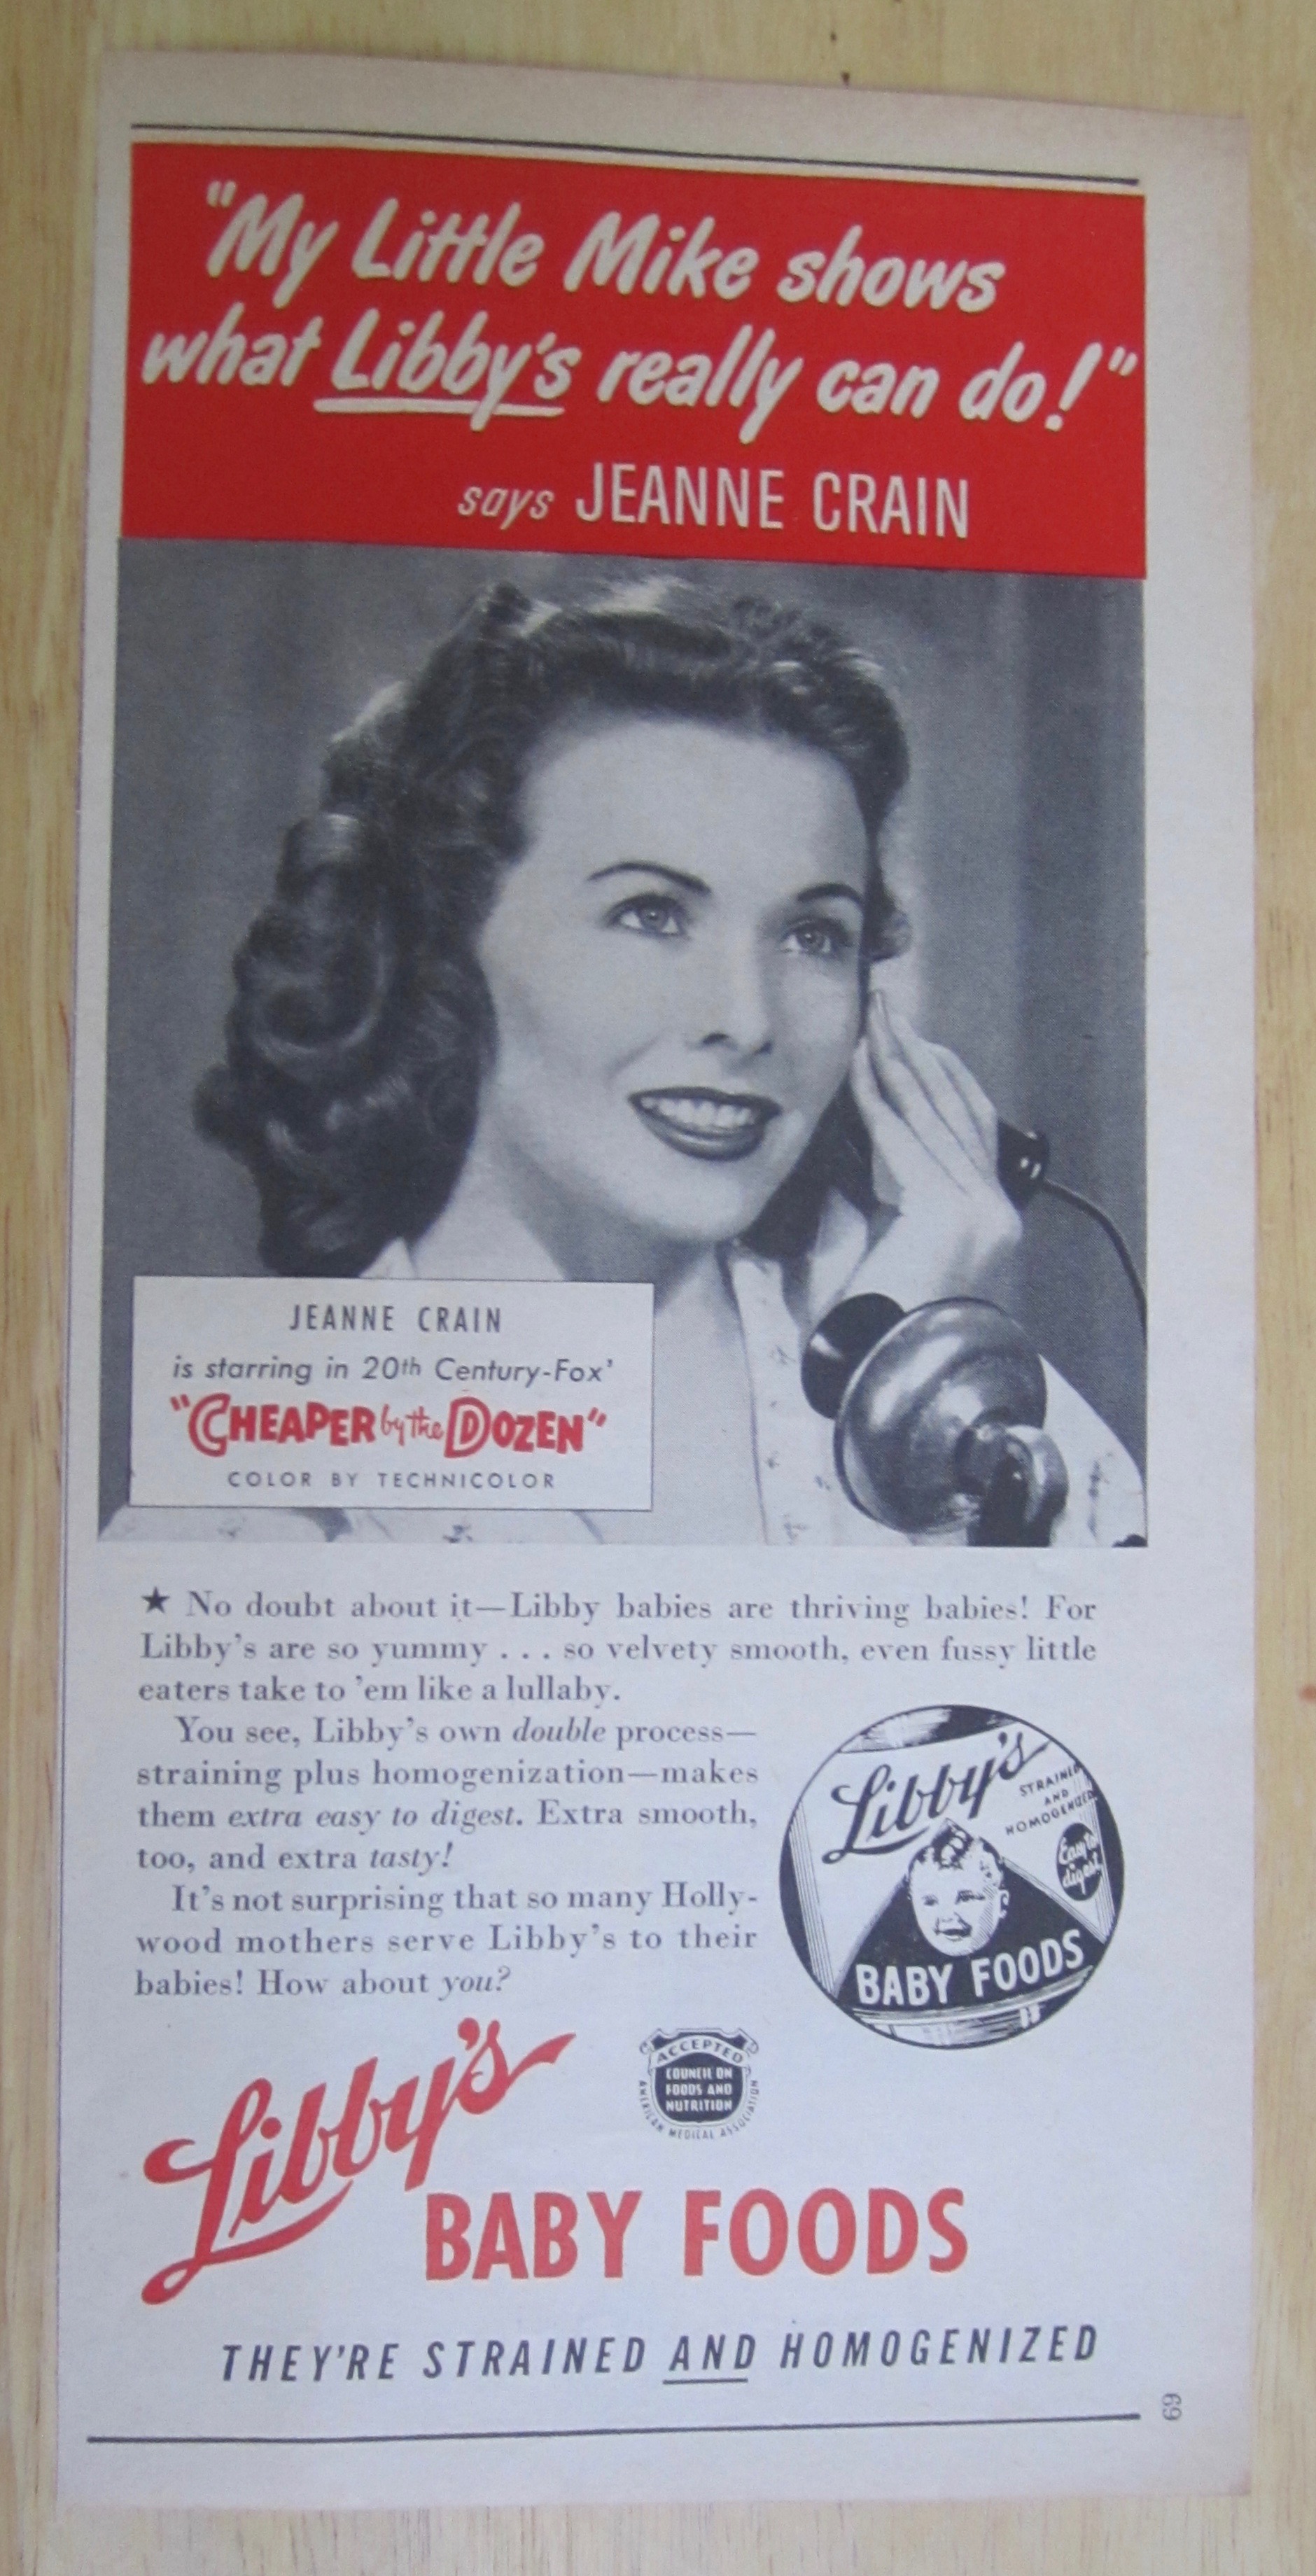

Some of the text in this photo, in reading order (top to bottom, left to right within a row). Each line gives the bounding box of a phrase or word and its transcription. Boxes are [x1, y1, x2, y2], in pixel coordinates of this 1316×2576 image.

[206, 180, 1006, 313] "My Little Mike shows
[141, 299, 1138, 444] what Libby's really can do!"
[457, 462, 968, 539] says JEANNE CRAIN
[289, 1303, 500, 1333] JEANNE CRAIN
[173, 1354, 193, 1379] is
[204, 1355, 313, 1386] starring
[326, 1355, 349, 1379] in
[361, 1355, 421, 1380] 20th
[171, 1393, 606, 1459] "CHEAPER by the DOZEN"
[227, 1471, 554, 1490] COLOR BY TECHNICOLOR
[189, 1590, 232, 1615] No
[246, 1591, 333, 1618] doubt
[351, 1592, 435, 1618] about
[617, 1592, 711, 1618] babies
[728, 1603, 773, 1618] are
[791, 1593, 909, 1628] thriving
[926, 1594, 1028, 1620] babies!
[1048, 1595, 1097, 1620] For
[141, 1632, 256, 1667] Libby's
[269, 1643, 315, 1659] are
[328, 1643, 359, 1659] so
[371, 1643, 487, 1668] yummy
[564, 1644, 594, 1659] so
[607, 1634, 717, 1669] velvety
[731, 1634, 848, 1661] smooth,
[860, 1645, 928, 1661] even
[941, 1635, 1015, 1670] fussy
[1028, 1634, 1096, 1661] little
[138, 1674, 620, 1709] eaters take to 'em like a lullaby.
[175, 1716, 233, 1743] You
[246, 1726, 300, 1748] see,
[314, 1716, 428, 1751] Libby's
[439, 1726, 500, 1742] own
[512, 1716, 606, 1742] double
[136, 1759, 282, 1794] straining
[293, 1758, 360, 1795] plus
[1019, 1763, 1080, 1797] STRAINED
[821, 1732, 1051, 1865] Libby's
[1044, 1789, 1069, 1806] AND
[138, 1799, 757, 1836] them extra easy to digest. Extra smooth,
[137, 1841, 454, 1877] too, and extra tasty!
[172, 1881, 757, 1920] It's not surprising that so many Holly-
[136, 1923, 757, 1959] wood mothers serve Libby's to their
[134, 1966, 511, 2002] babies! How about you?
[856, 1928, 1085, 2006] BABY FOODS
[657, 2038, 743, 2064] ACCEPTED
[666, 2066, 733, 2080] COUNCIL ON
[666, 2083, 732, 2096] FOODS AND
[666, 2099, 732, 2112] NUTRITION
[668, 2128, 714, 2140] MEDICAL
[139, 2016, 578, 2306] Libby's
[426, 2188, 967, 2281] BABY FOODS
[223, 2324, 1097, 2382] THEY'RE STRAINED AND HOMOGENIZED
[1162, 2393, 1182, 2421] 69
